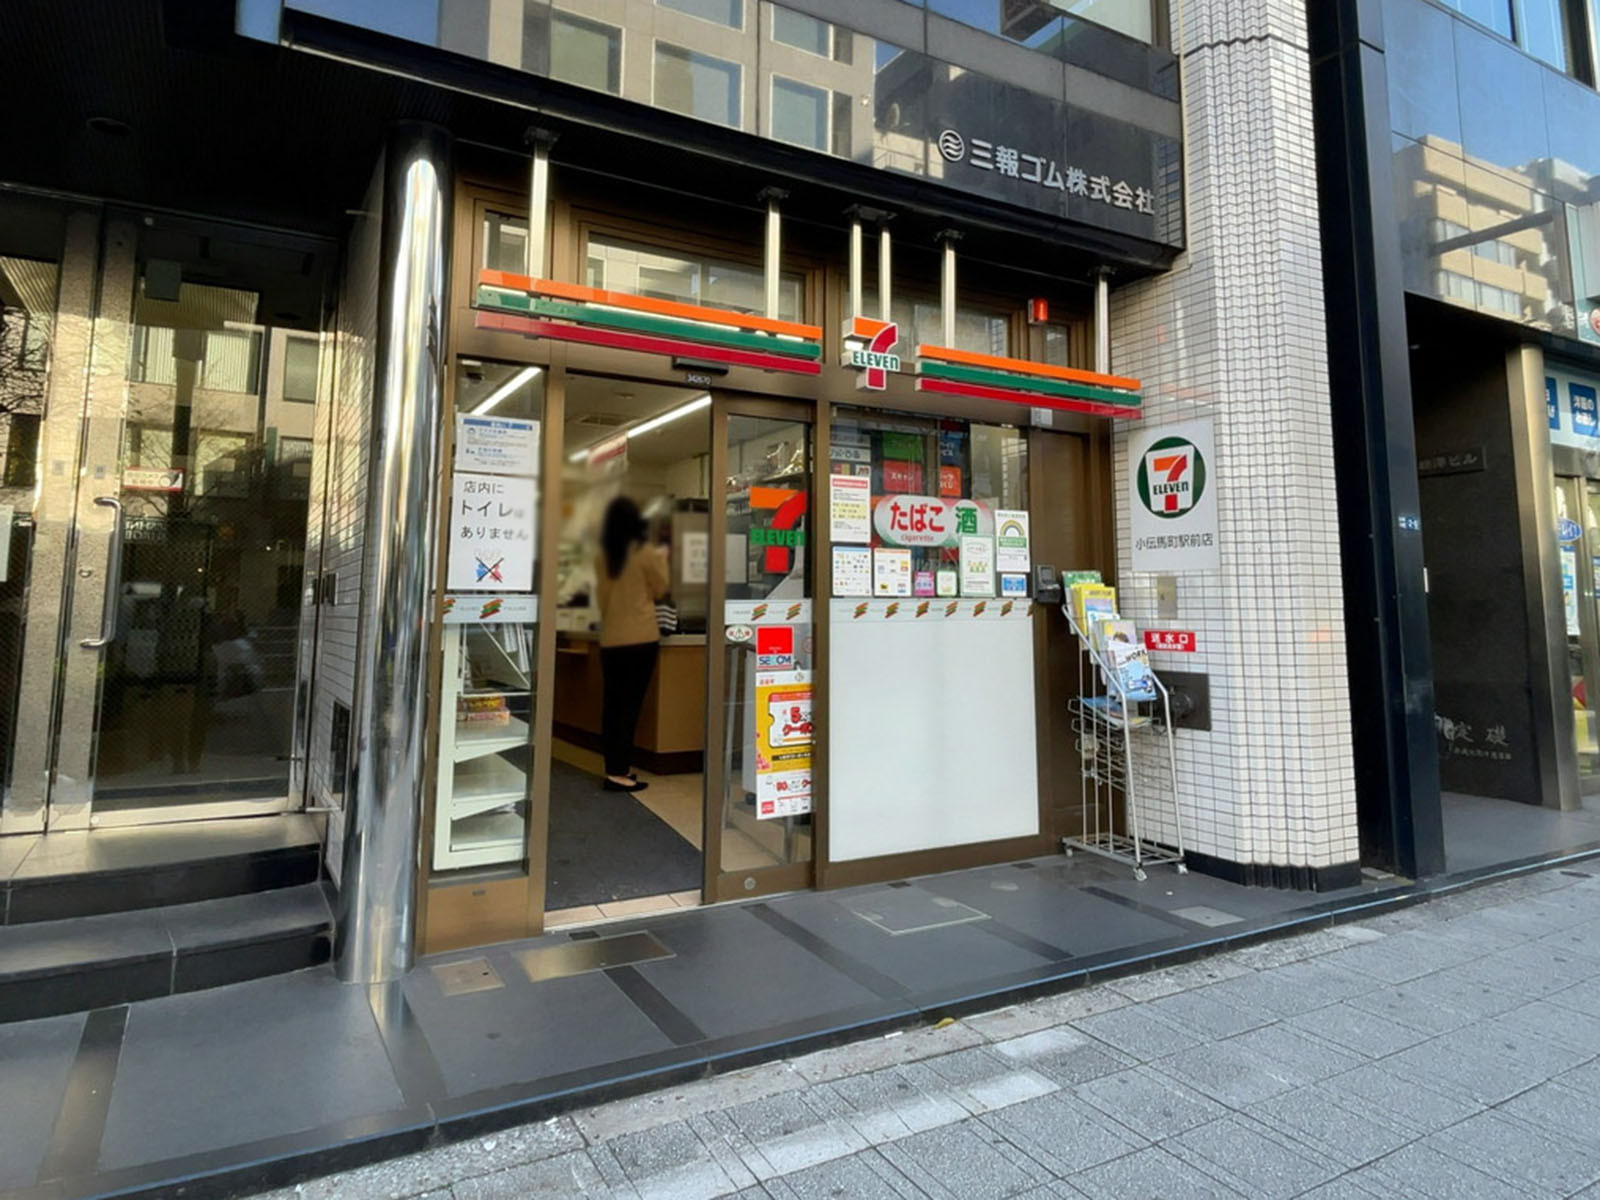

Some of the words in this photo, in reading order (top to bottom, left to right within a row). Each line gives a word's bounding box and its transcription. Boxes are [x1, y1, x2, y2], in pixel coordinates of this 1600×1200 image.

[970, 138, 1155, 215] 三報ゴム株式会社
[463, 481, 504, 494] 店内に
[890, 502, 945, 533] たばこ
[955, 506, 978, 534] 酒
[460, 526, 528, 541] ありません
[1135, 533, 1214, 551] 小伝馬町駅前店
[758, 655, 792, 666] SEOM
